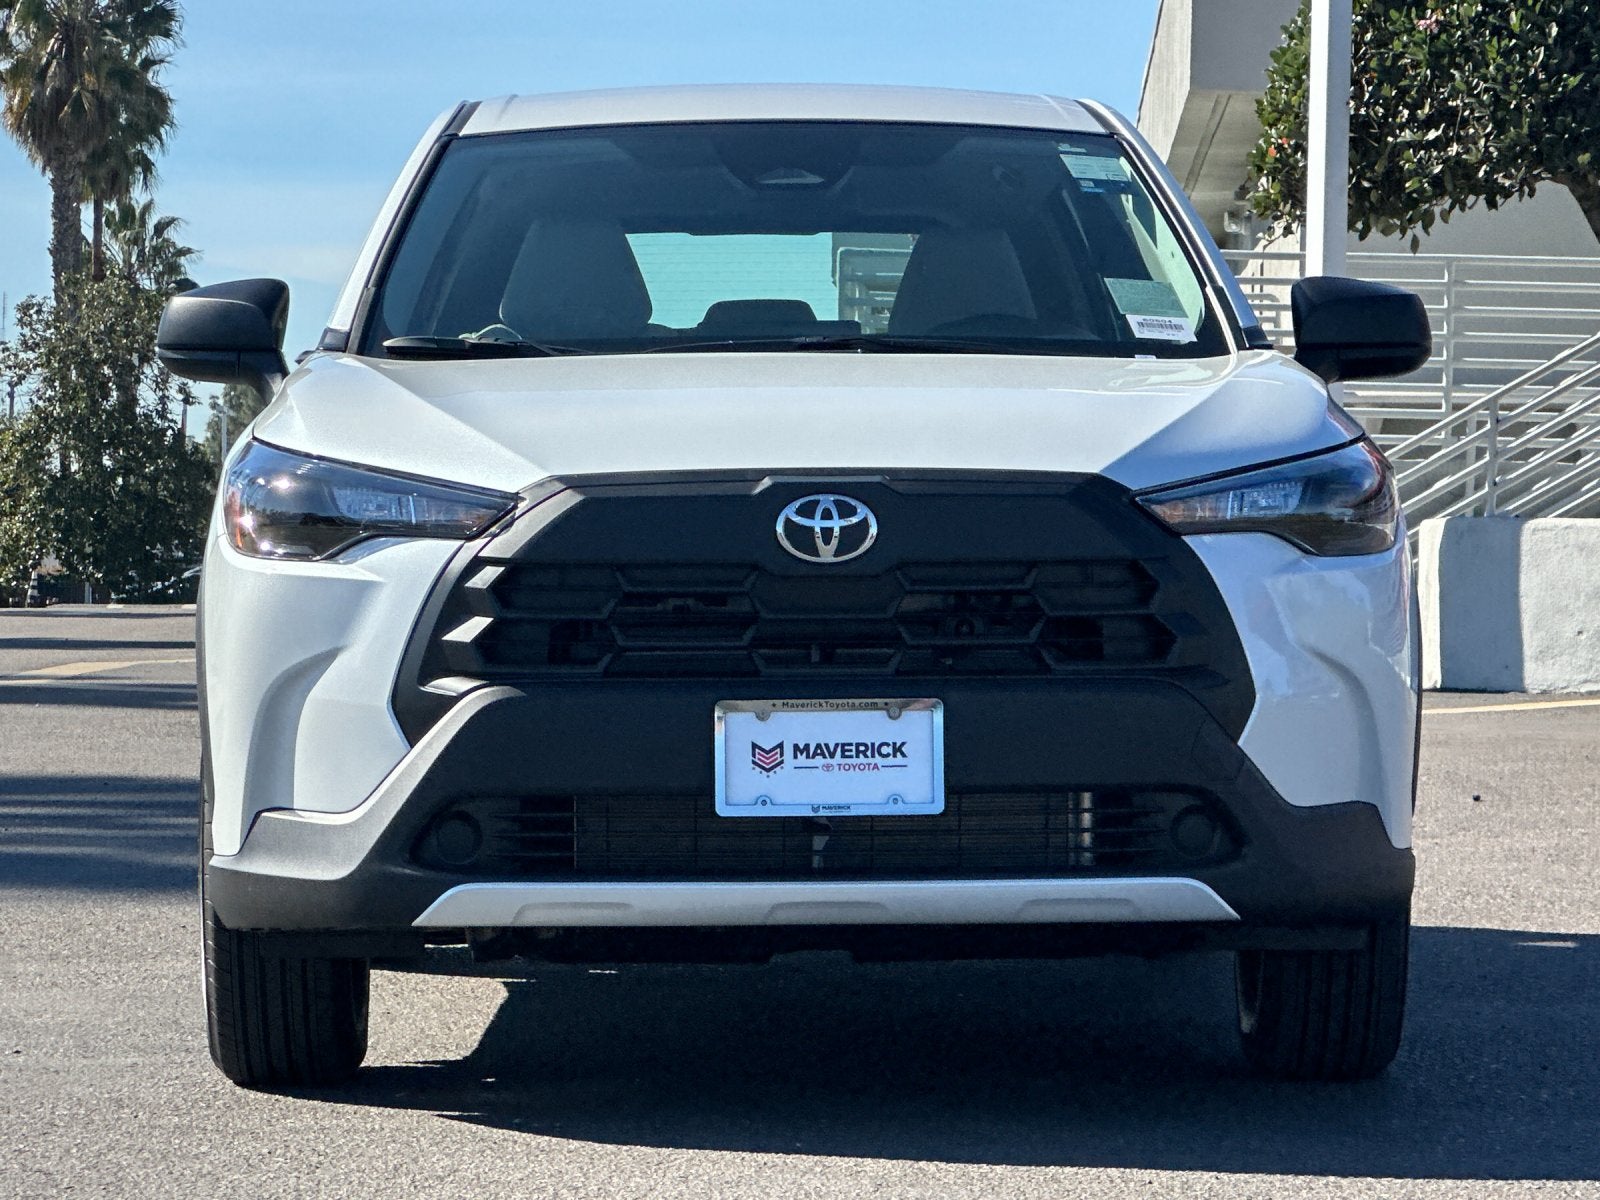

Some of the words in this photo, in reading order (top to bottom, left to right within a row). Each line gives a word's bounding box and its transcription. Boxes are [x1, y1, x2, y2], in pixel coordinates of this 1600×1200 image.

[782, 700, 879, 709] MaverickToyota.com
[793, 741, 908, 759] MAVERICK
[837, 762, 880, 771] TOYOTA
